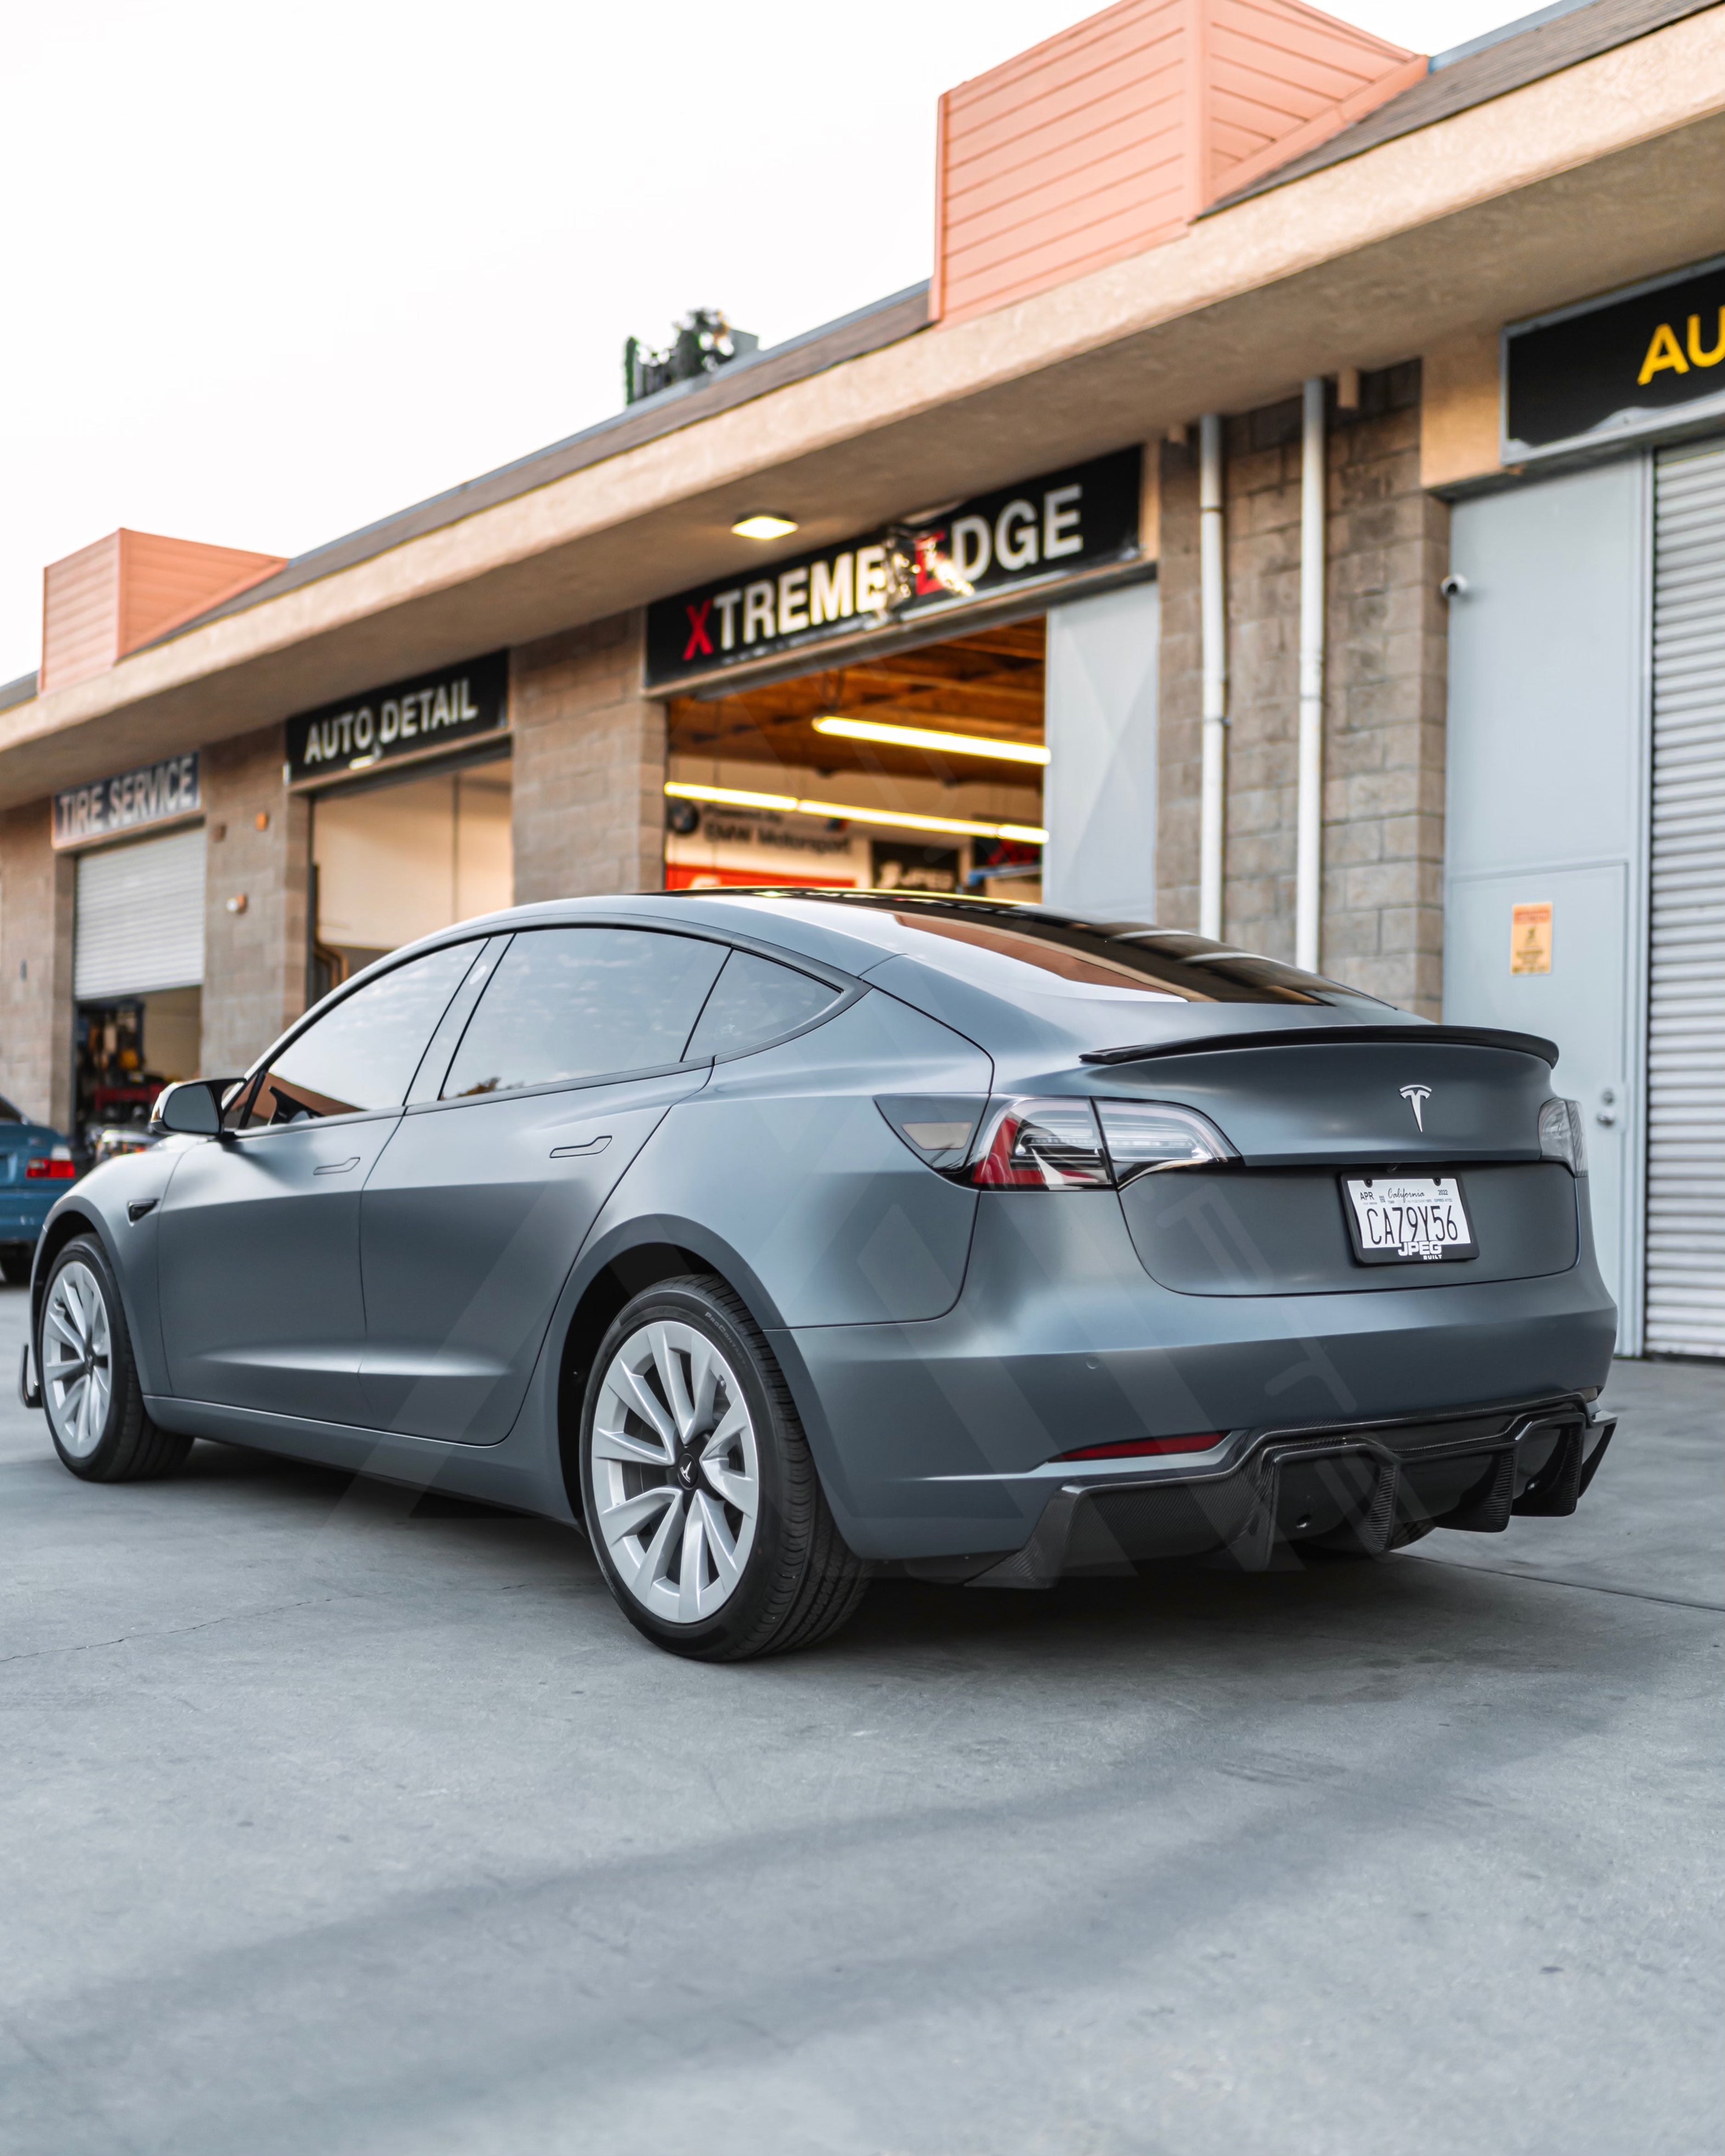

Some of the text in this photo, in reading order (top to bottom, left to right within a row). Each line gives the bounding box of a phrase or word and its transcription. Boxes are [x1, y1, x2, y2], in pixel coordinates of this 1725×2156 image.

[683, 543, 888, 660] XTREME
[304, 679, 478, 764] AUTO DETAIL
[59, 756, 198, 836] TIRE SERVICE
[1360, 1191, 1374, 1201] APR
[1387, 1187, 1425, 1203] California
[1367, 1205, 1458, 1245] CA79Y56
[1398, 1241, 1442, 1256] JPEG
